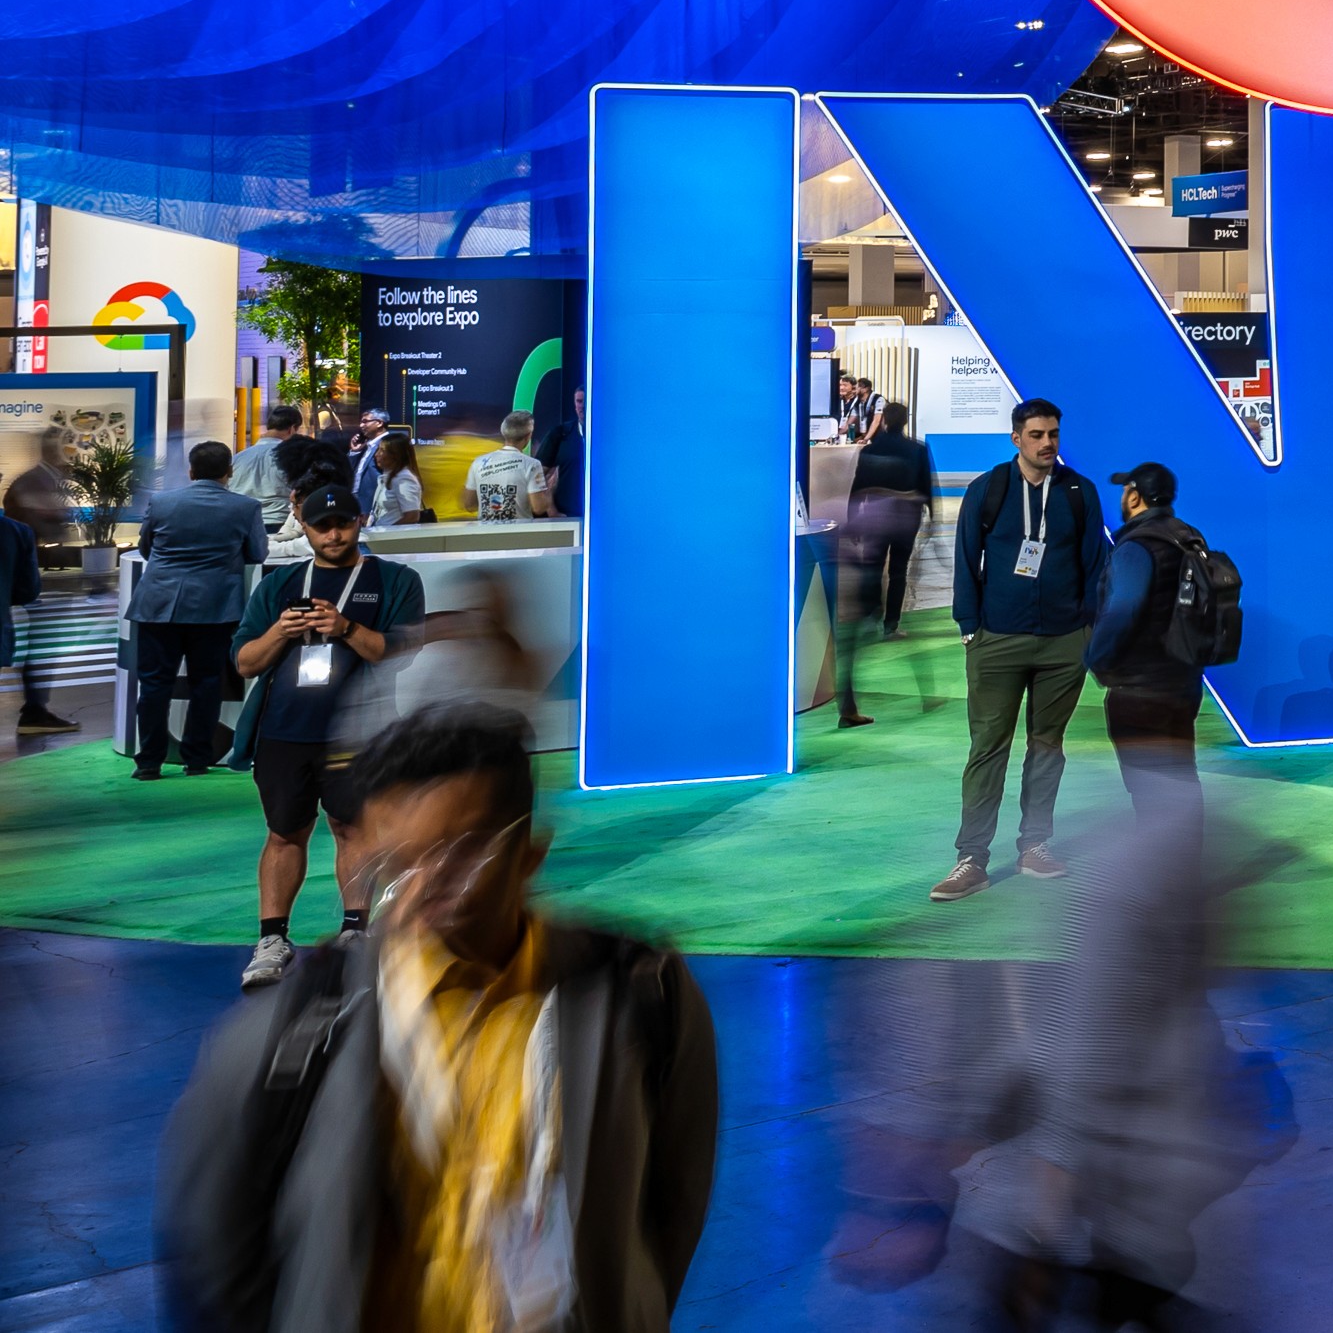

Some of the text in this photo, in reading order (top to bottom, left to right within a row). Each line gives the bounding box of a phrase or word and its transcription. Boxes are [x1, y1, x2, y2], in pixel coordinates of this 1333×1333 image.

[1181, 186, 1218, 202] HCLTech
[1213, 229, 1239, 240] pwc
[378, 285, 478, 305] Follow the lines
[378, 307, 480, 330] to explore Expo
[951, 356, 990, 367] Helping
[407, 368, 431, 376] Developer
[431, 368, 457, 376] Community
[951, 366, 988, 376] helpers
[417, 400, 439, 409] Meetings
